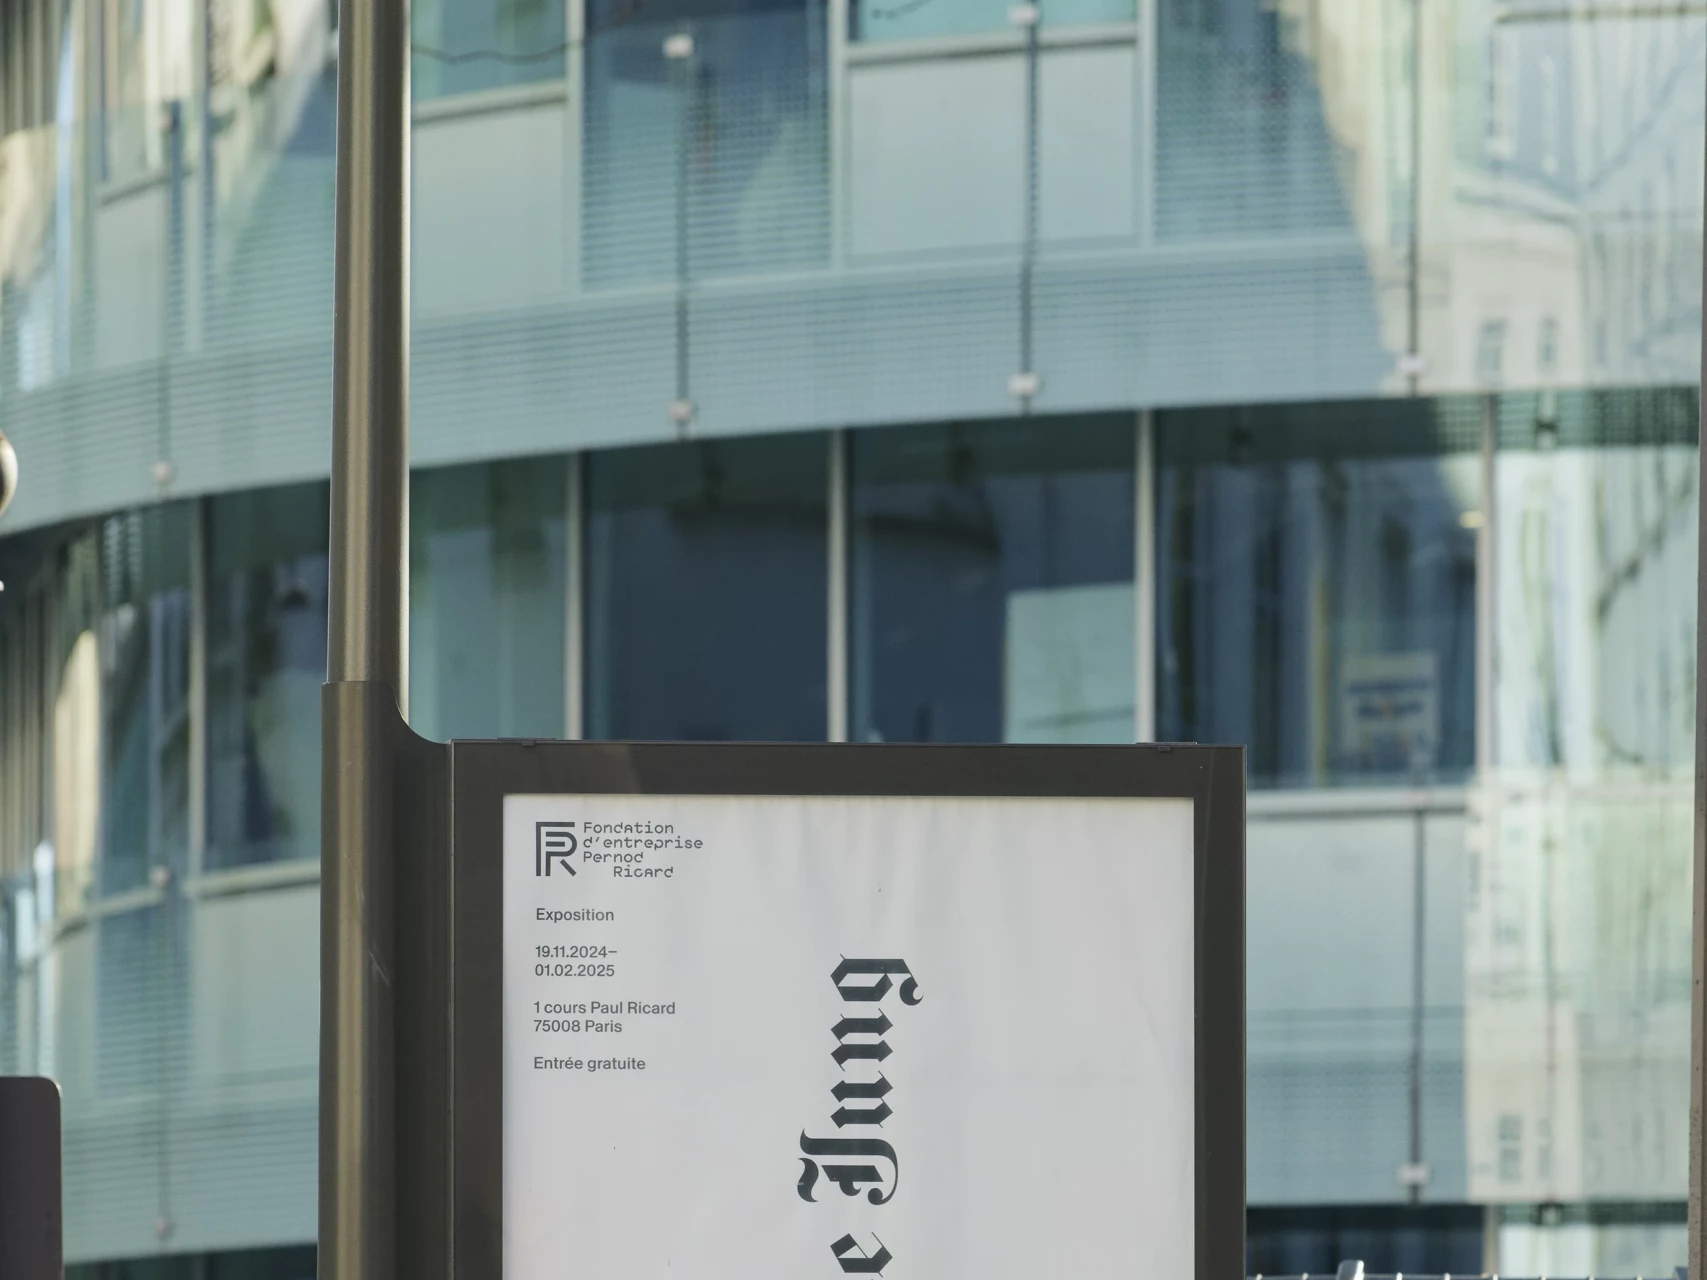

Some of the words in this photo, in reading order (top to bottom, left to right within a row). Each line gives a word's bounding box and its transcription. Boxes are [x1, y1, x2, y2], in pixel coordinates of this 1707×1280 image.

[583, 821, 674, 834] Fondation
[583, 837, 703, 850] d'entreprise
[583, 851, 644, 863] Pernod
[613, 866, 674, 878] Ricard
[536, 908, 615, 923] Exposition
[534, 964, 615, 977] 01.02.2025
[534, 1001, 540, 1014] 1
[544, 1004, 586, 1014] cours
[590, 1001, 623, 1014] Paul
[627, 1001, 676, 1015] Ricard
[534, 1020, 581, 1032] 75008
[585, 1020, 622, 1033] Paris
[534, 1056, 583, 1070] Entrée
[587, 1058, 646, 1072] gratuite
[797, 952, 924, 1206] Jung
